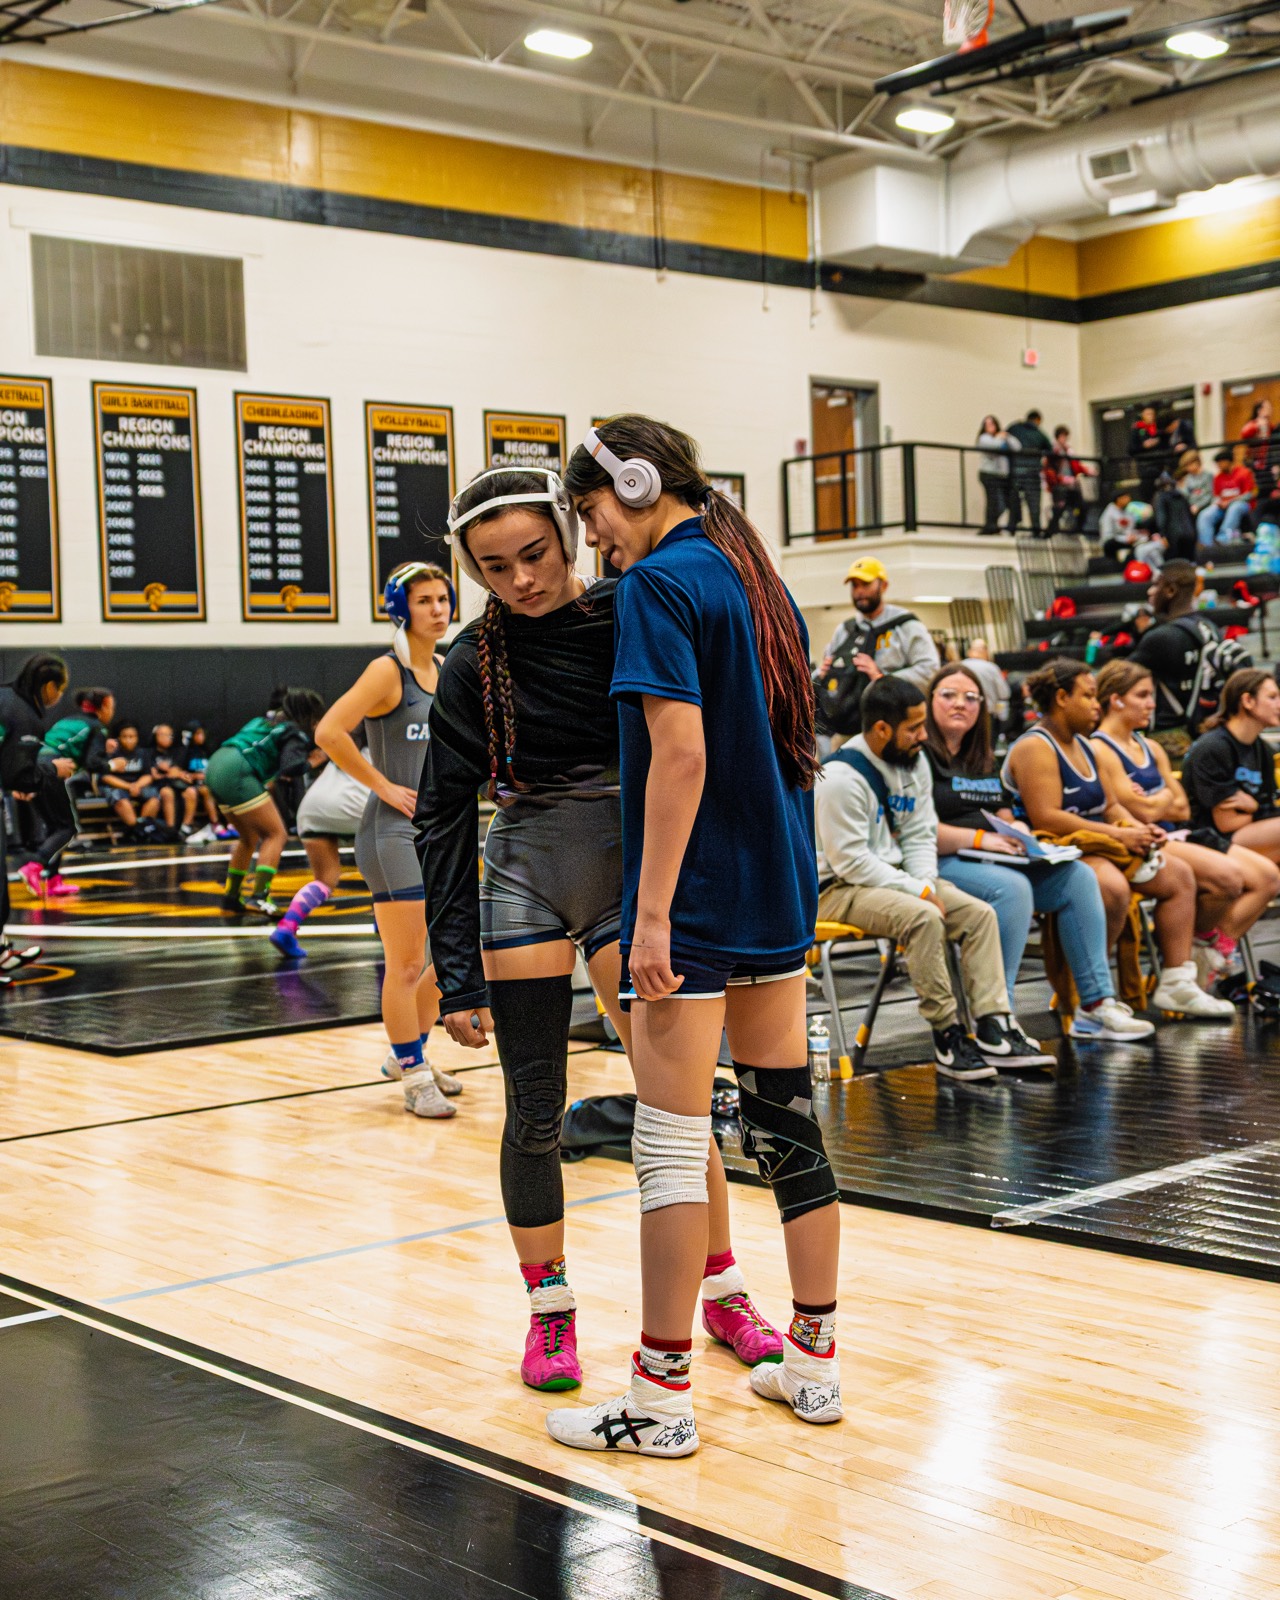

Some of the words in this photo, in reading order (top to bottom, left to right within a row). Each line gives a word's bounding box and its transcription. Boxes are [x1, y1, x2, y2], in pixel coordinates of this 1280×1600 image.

[102, 395, 128, 408] GIRLS
[131, 397, 186, 411] BASKETBALL
[246, 406, 319, 420] CHEERLEADING
[377, 415, 441, 428] VOLLEYBALL
[118, 416, 174, 434] REGION
[258, 425, 310, 442] REGION
[102, 430, 190, 451] CHAMPIONS
[243, 439, 325, 459] CHAMPIONS
[386, 434, 435, 449] REGION
[504, 440, 549, 457] REGION
[373, 446, 448, 465] CHAMPIONS
[491, 453, 561, 472] CHAMPIONS
